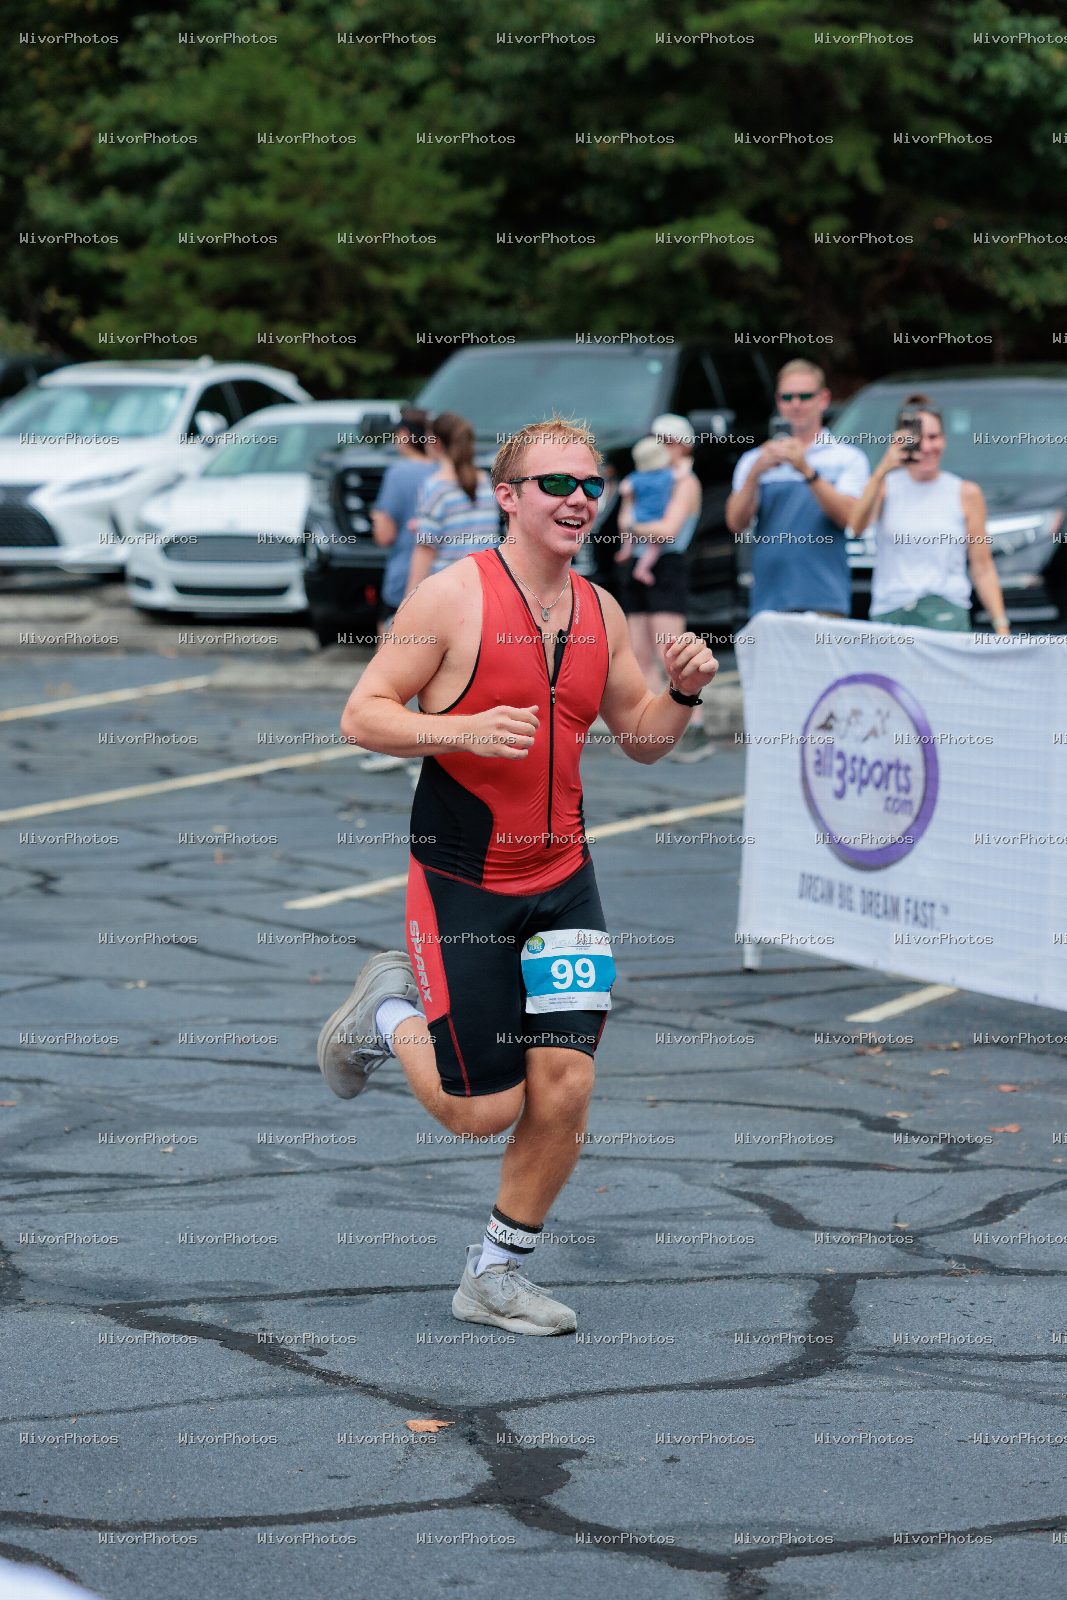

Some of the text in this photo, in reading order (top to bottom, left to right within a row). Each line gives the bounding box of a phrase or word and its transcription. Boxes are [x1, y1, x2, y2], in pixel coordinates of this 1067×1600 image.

[814, 744, 911, 800] all3sports
[860, 888, 900, 924] DREAM
[550, 957, 596, 990] 99
